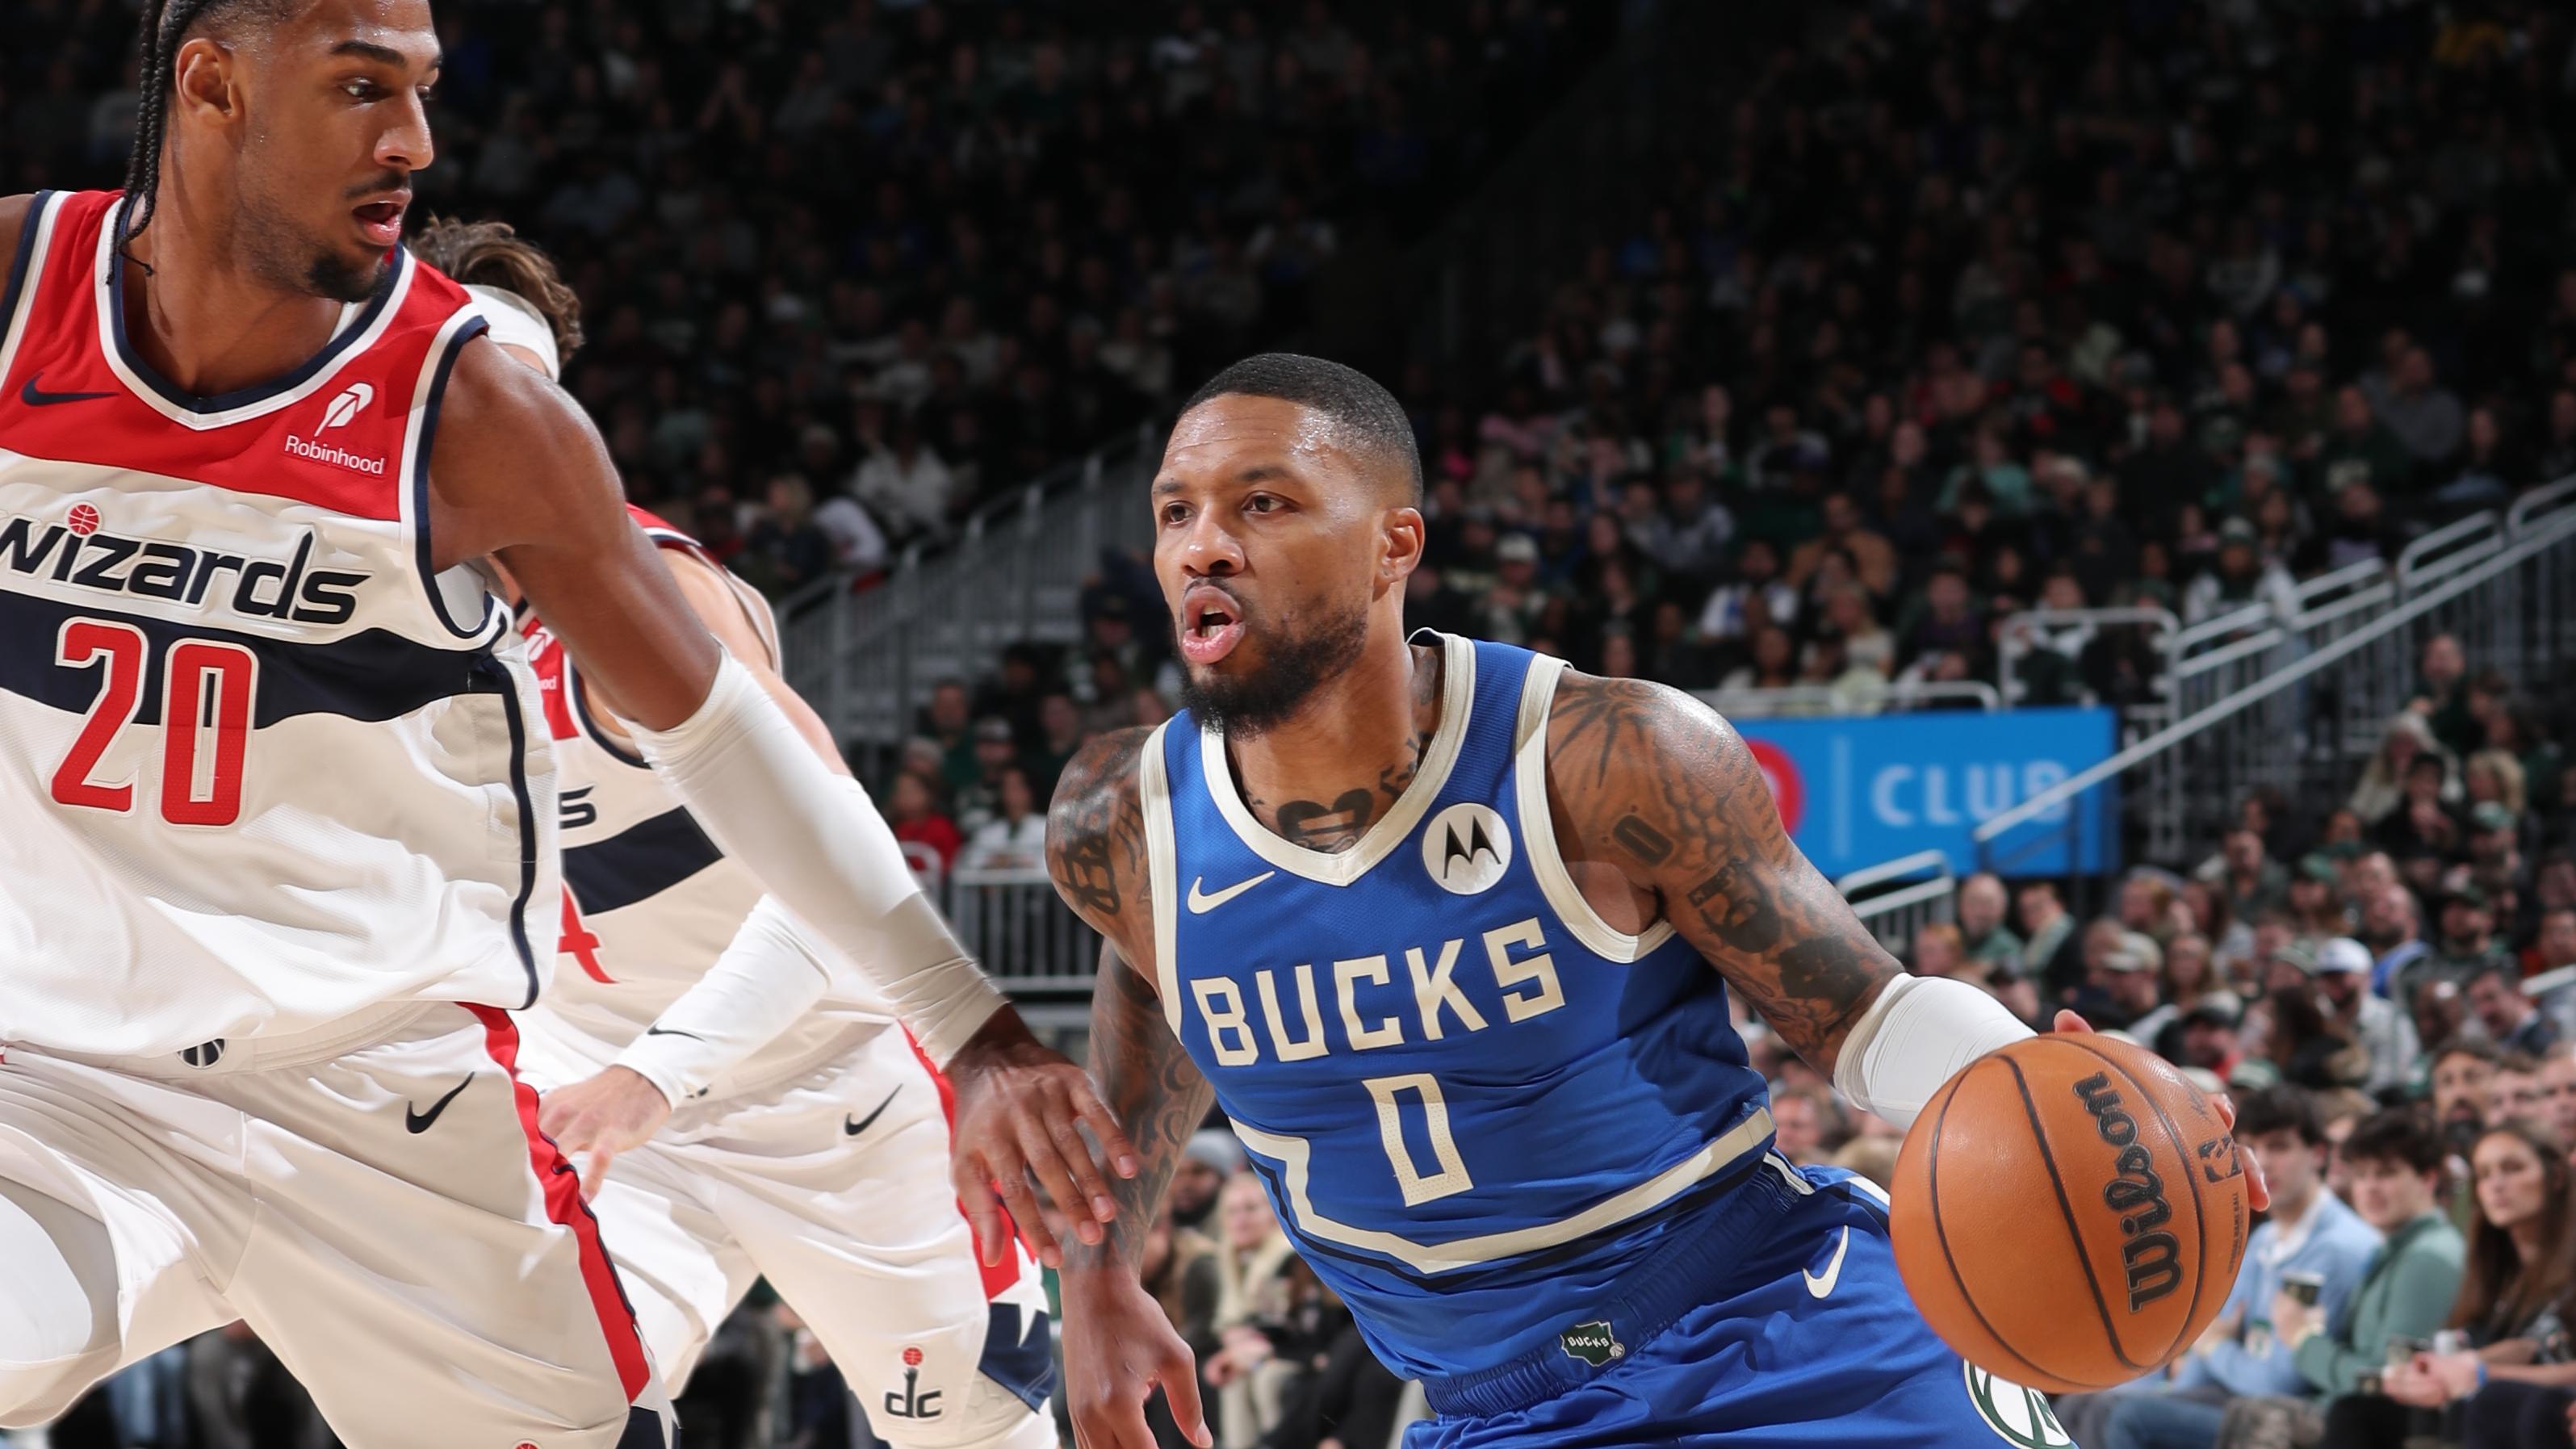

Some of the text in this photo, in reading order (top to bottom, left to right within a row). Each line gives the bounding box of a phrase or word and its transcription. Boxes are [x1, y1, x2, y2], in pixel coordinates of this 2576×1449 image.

[284, 434, 385, 475] Robinhood
[52, 621, 253, 826] 20
[1871, 760, 2072, 827] CLUB
[1190, 918, 1565, 1066] BUCKS
[1362, 1074, 1474, 1208] 0
[2073, 1071, 2183, 1313] Wilson
[1567, 1336, 1610, 1348] BUCKS
